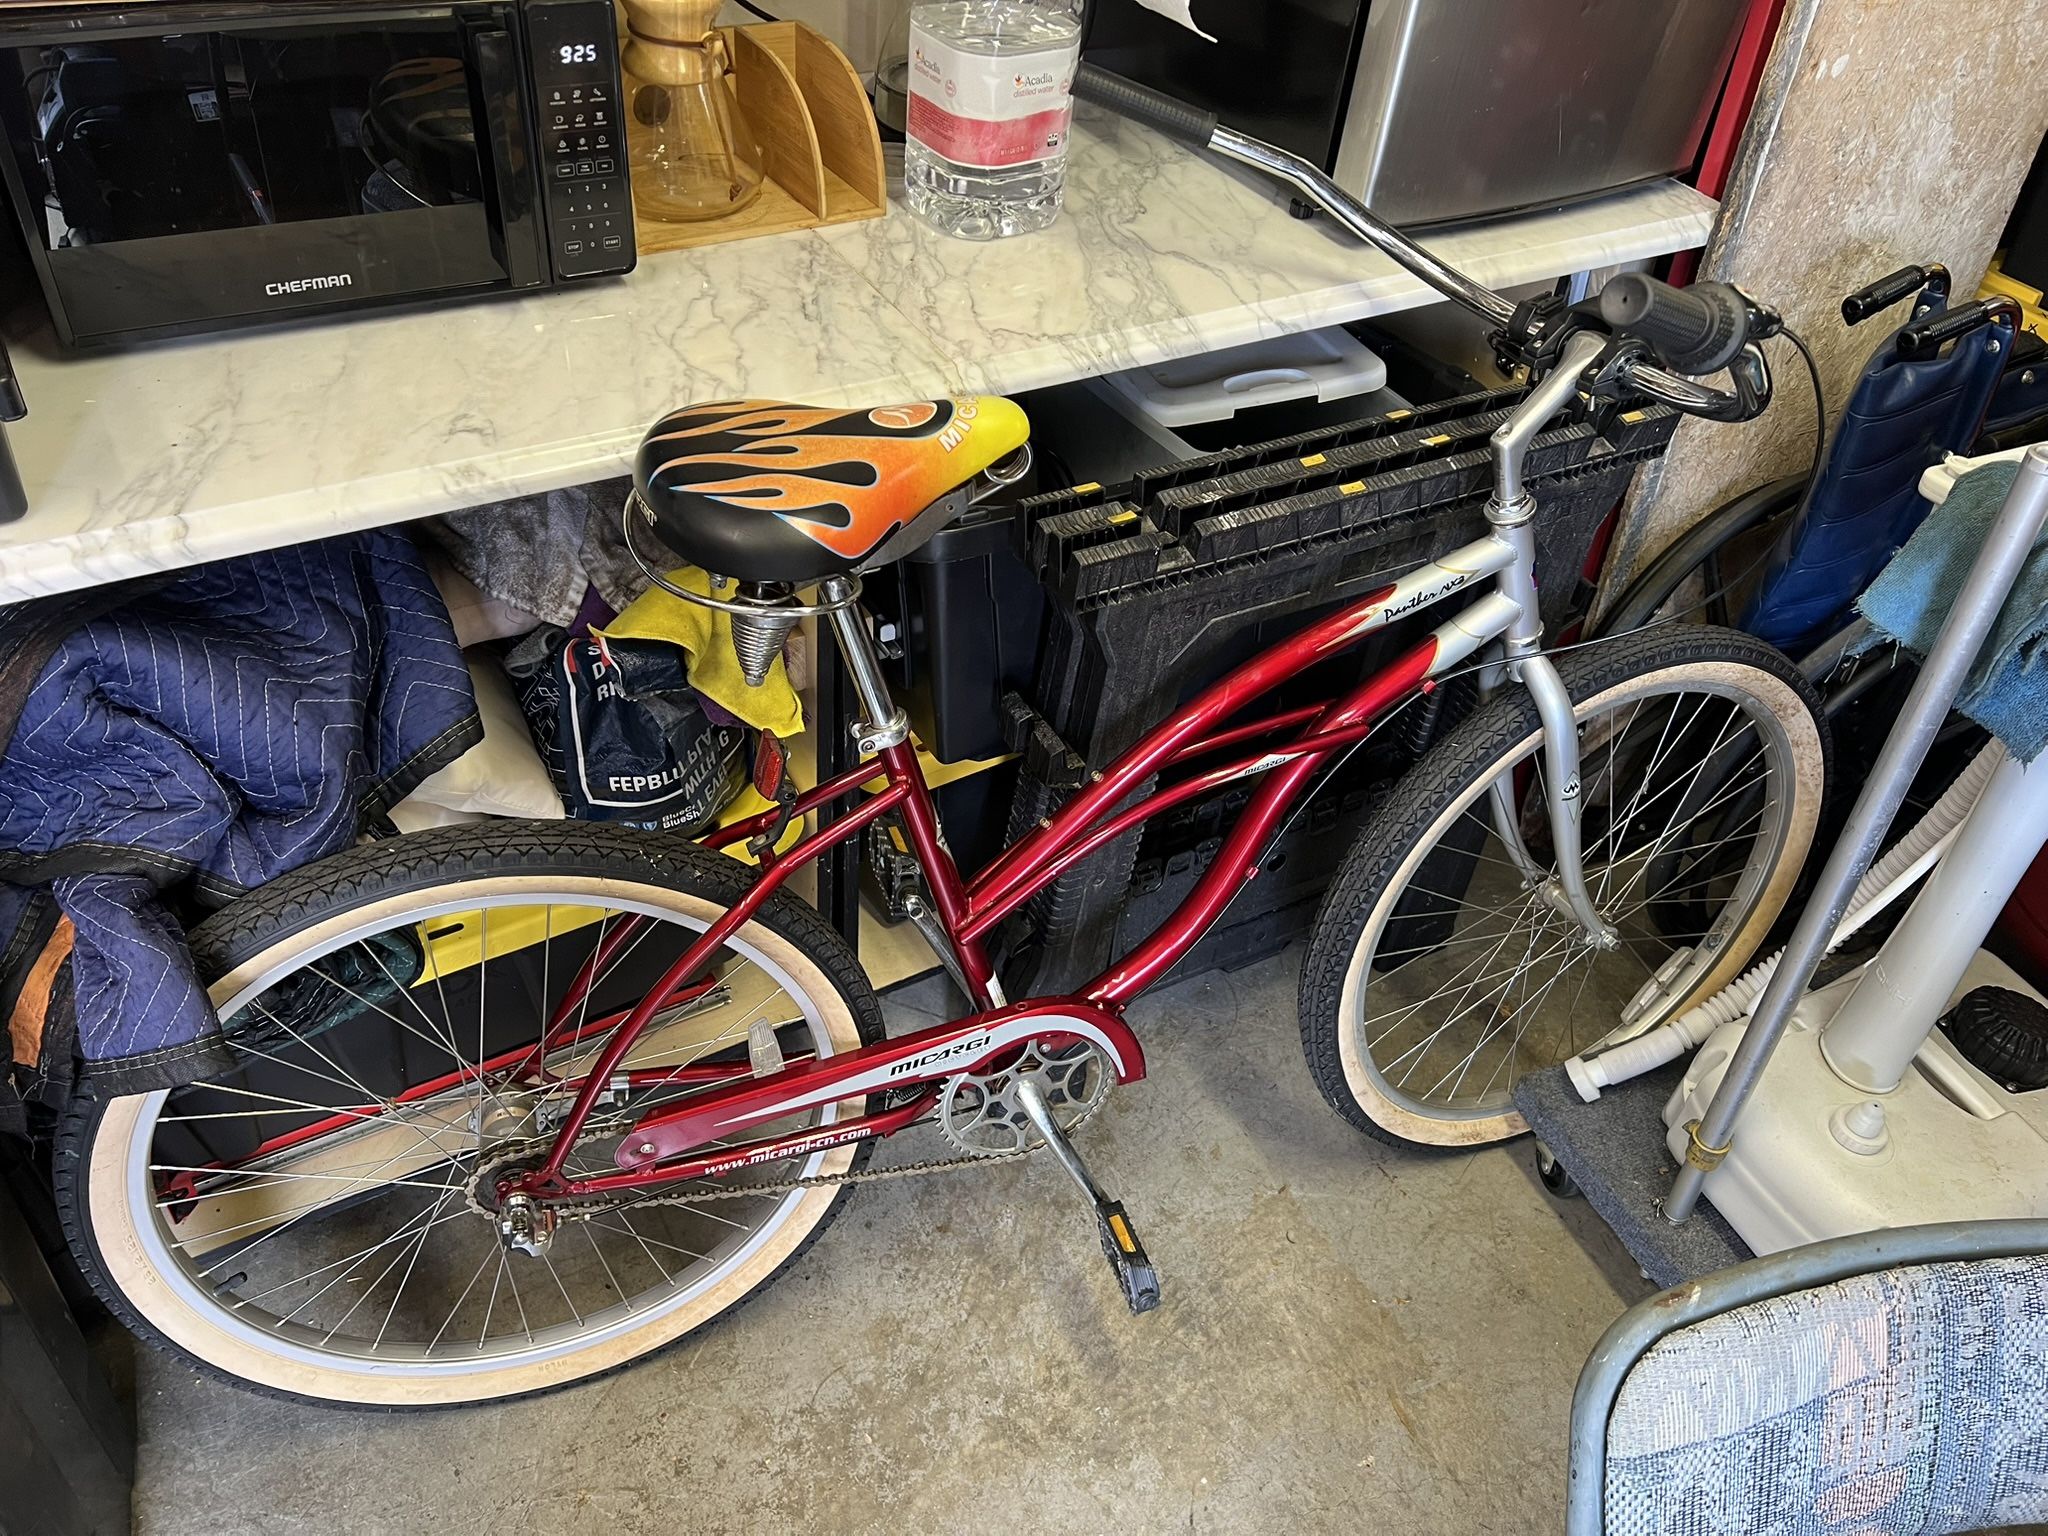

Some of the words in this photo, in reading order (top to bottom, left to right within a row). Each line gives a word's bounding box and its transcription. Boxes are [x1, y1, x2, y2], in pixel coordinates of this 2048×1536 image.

[1013, 86, 1037, 98] distilled
[1038, 85, 1055, 95] water
[1024, 73, 1053, 87] Acadia
[265, 273, 352, 296] CHEFMAN
[1384, 591, 1438, 622] Panther
[1244, 756, 1286, 776] MICARGI
[889, 1035, 992, 1077] MICARGI
[703, 1127, 872, 1175] www.micargi-cn.com
